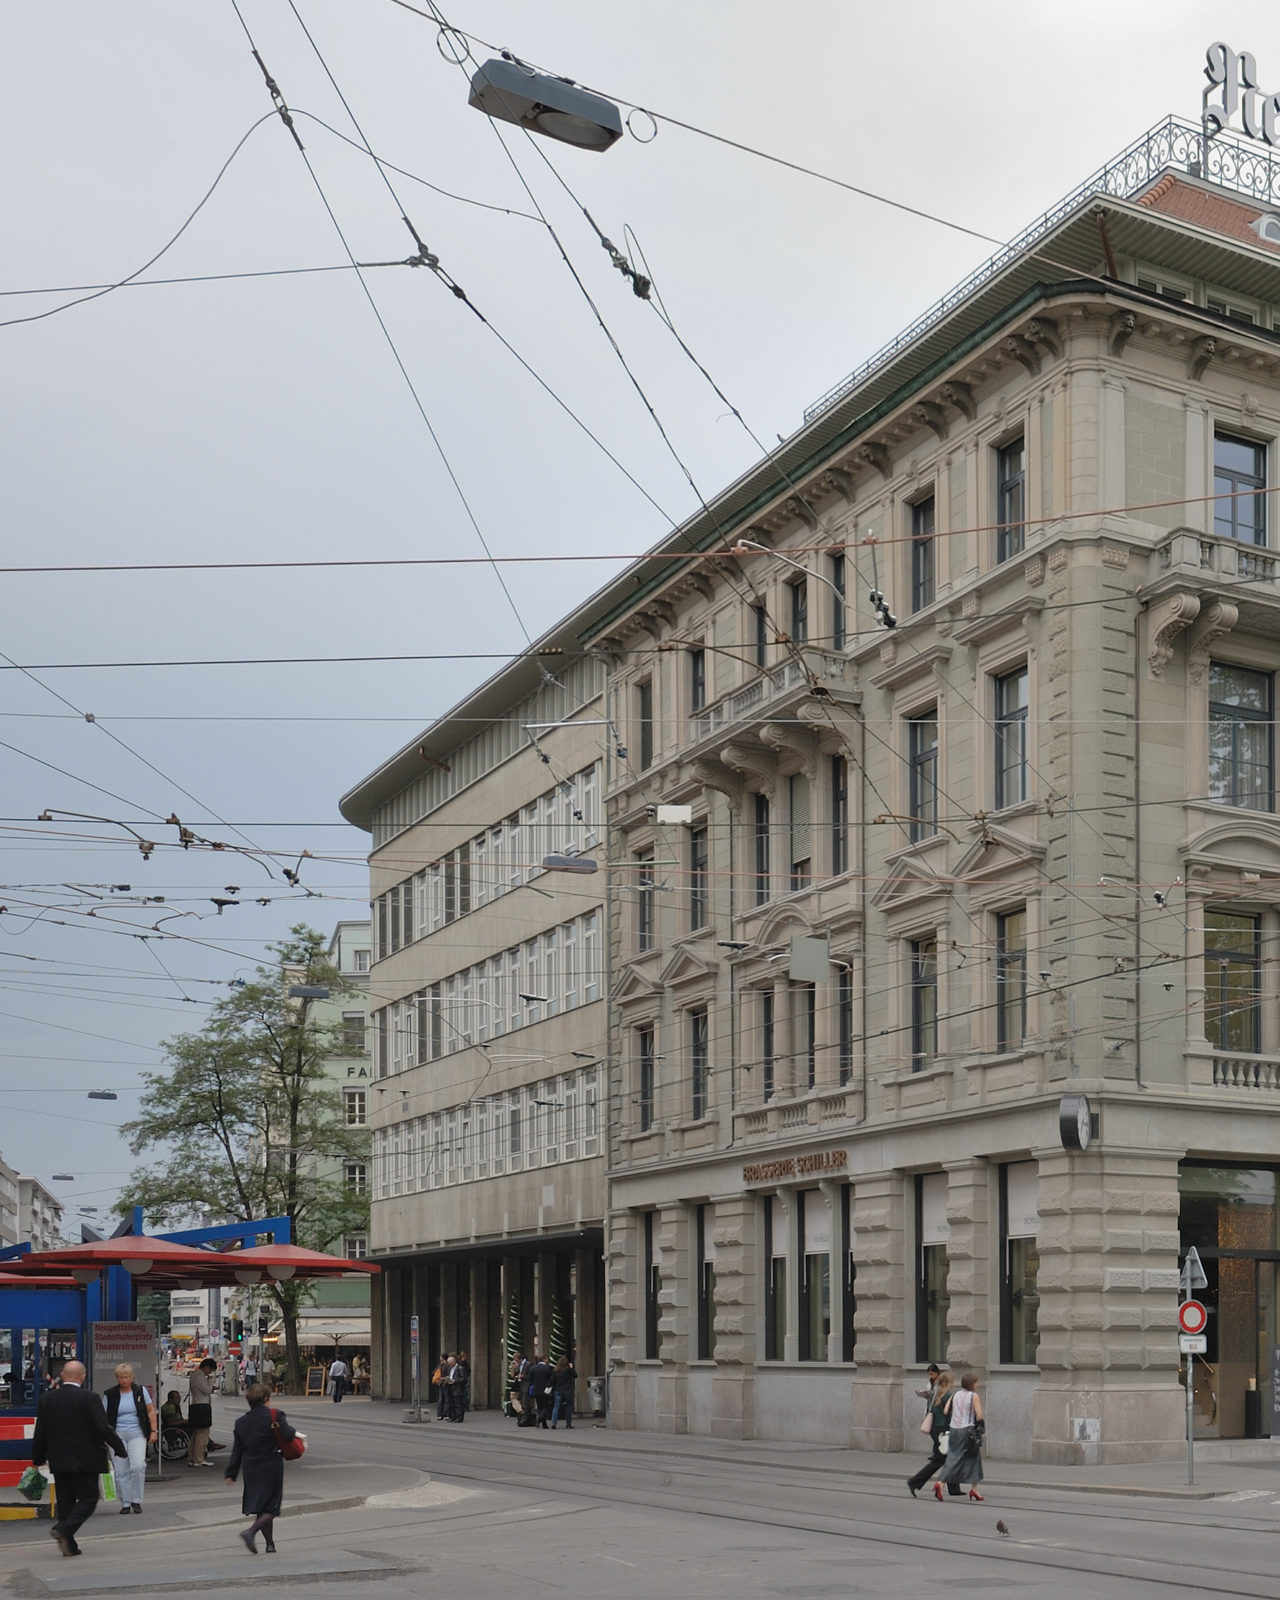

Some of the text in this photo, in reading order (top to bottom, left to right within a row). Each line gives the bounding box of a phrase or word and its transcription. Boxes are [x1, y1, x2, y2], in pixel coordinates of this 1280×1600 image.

[347, 1067, 372, 1078] FA
[743, 1150, 847, 1181] BRASSERIE SCHILLER
[95, 1323, 146, 1332] Neugestaltung
[95, 1333, 153, 1342] Stadelhoferplatz
